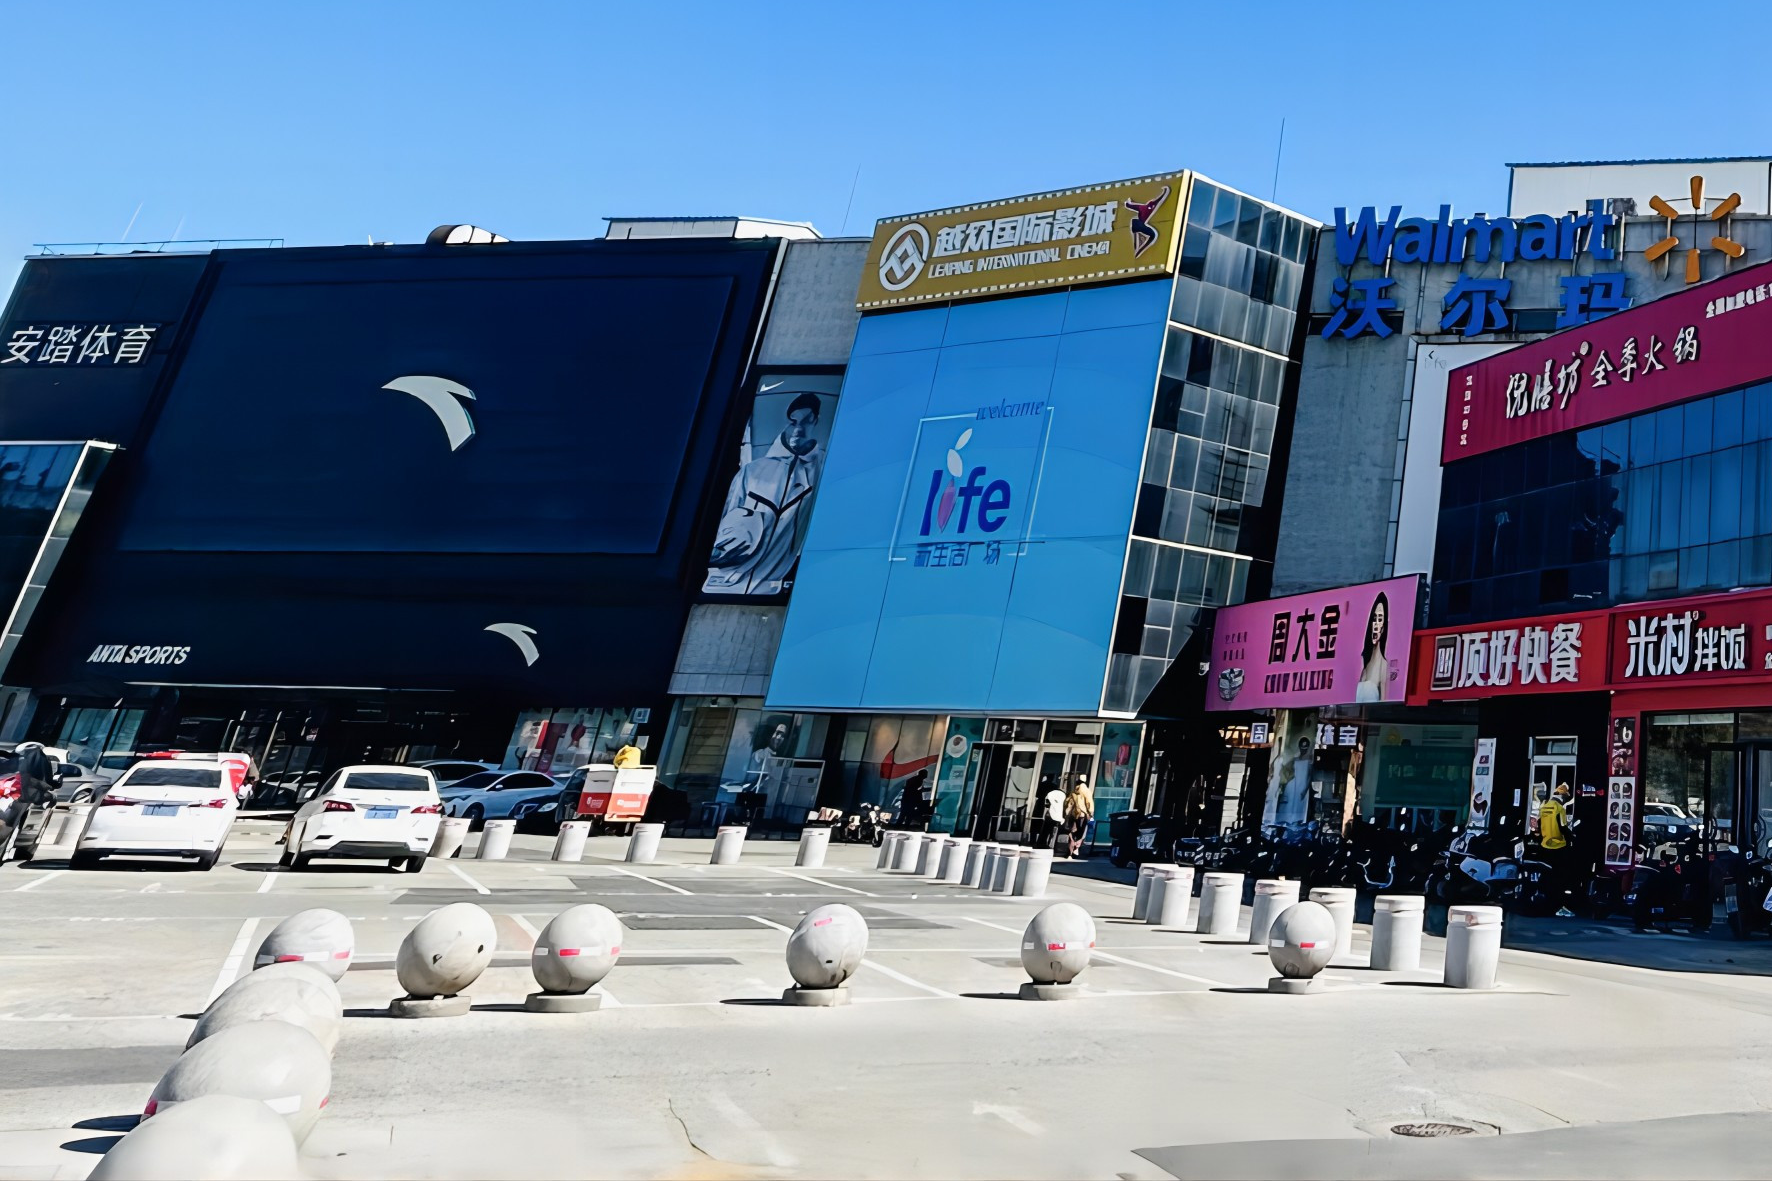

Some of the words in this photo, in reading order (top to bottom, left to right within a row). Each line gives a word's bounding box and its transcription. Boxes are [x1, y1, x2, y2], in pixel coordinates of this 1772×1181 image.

[932, 201, 1118, 257] 越众国际影城
[1334, 199, 1616, 265] Walmart
[1321, 272, 1634, 339] 沃尔玛
[1, 324, 157, 363] 安踏体育
[86, 645, 128, 663] ANTA
[124, 646, 191, 665] SPORTS
[1458, 623, 1582, 687] 顶好快餐
[1625, 612, 1745, 677] 米村拌饭
